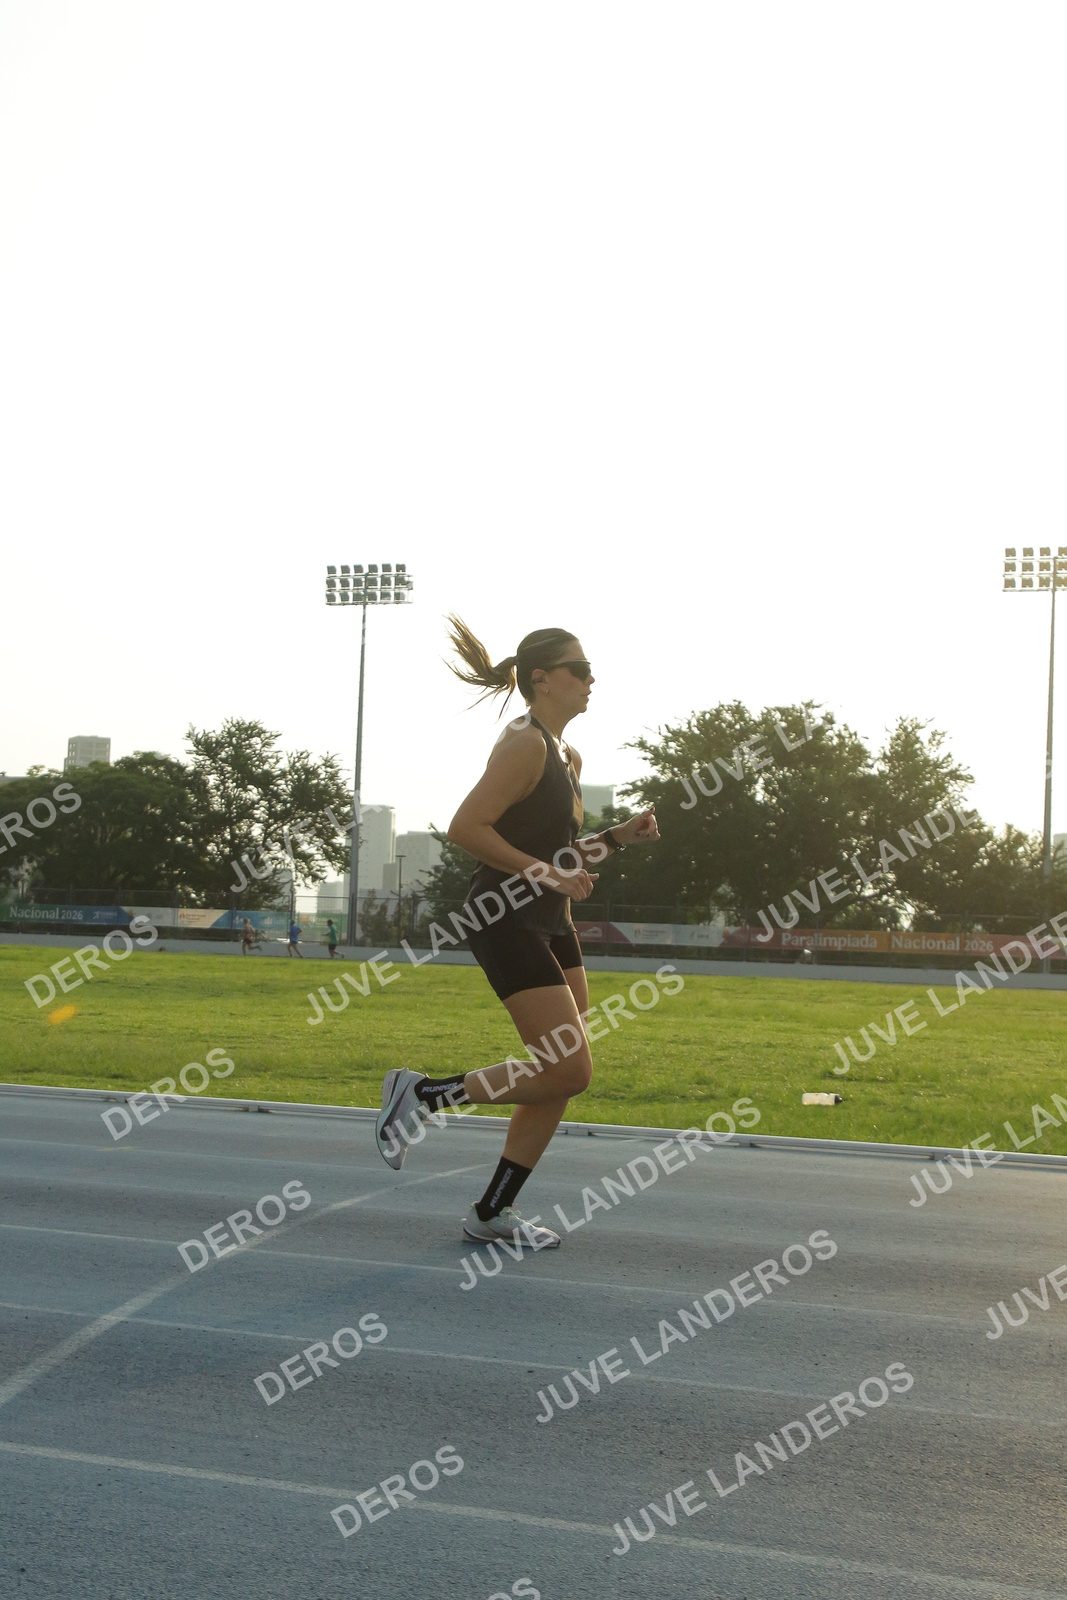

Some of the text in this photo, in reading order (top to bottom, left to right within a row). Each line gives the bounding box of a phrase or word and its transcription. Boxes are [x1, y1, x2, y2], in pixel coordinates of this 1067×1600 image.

[9, 906, 84, 920] Nacional 2026
[781, 932, 994, 952] Paralimpiada Nacional 2026
